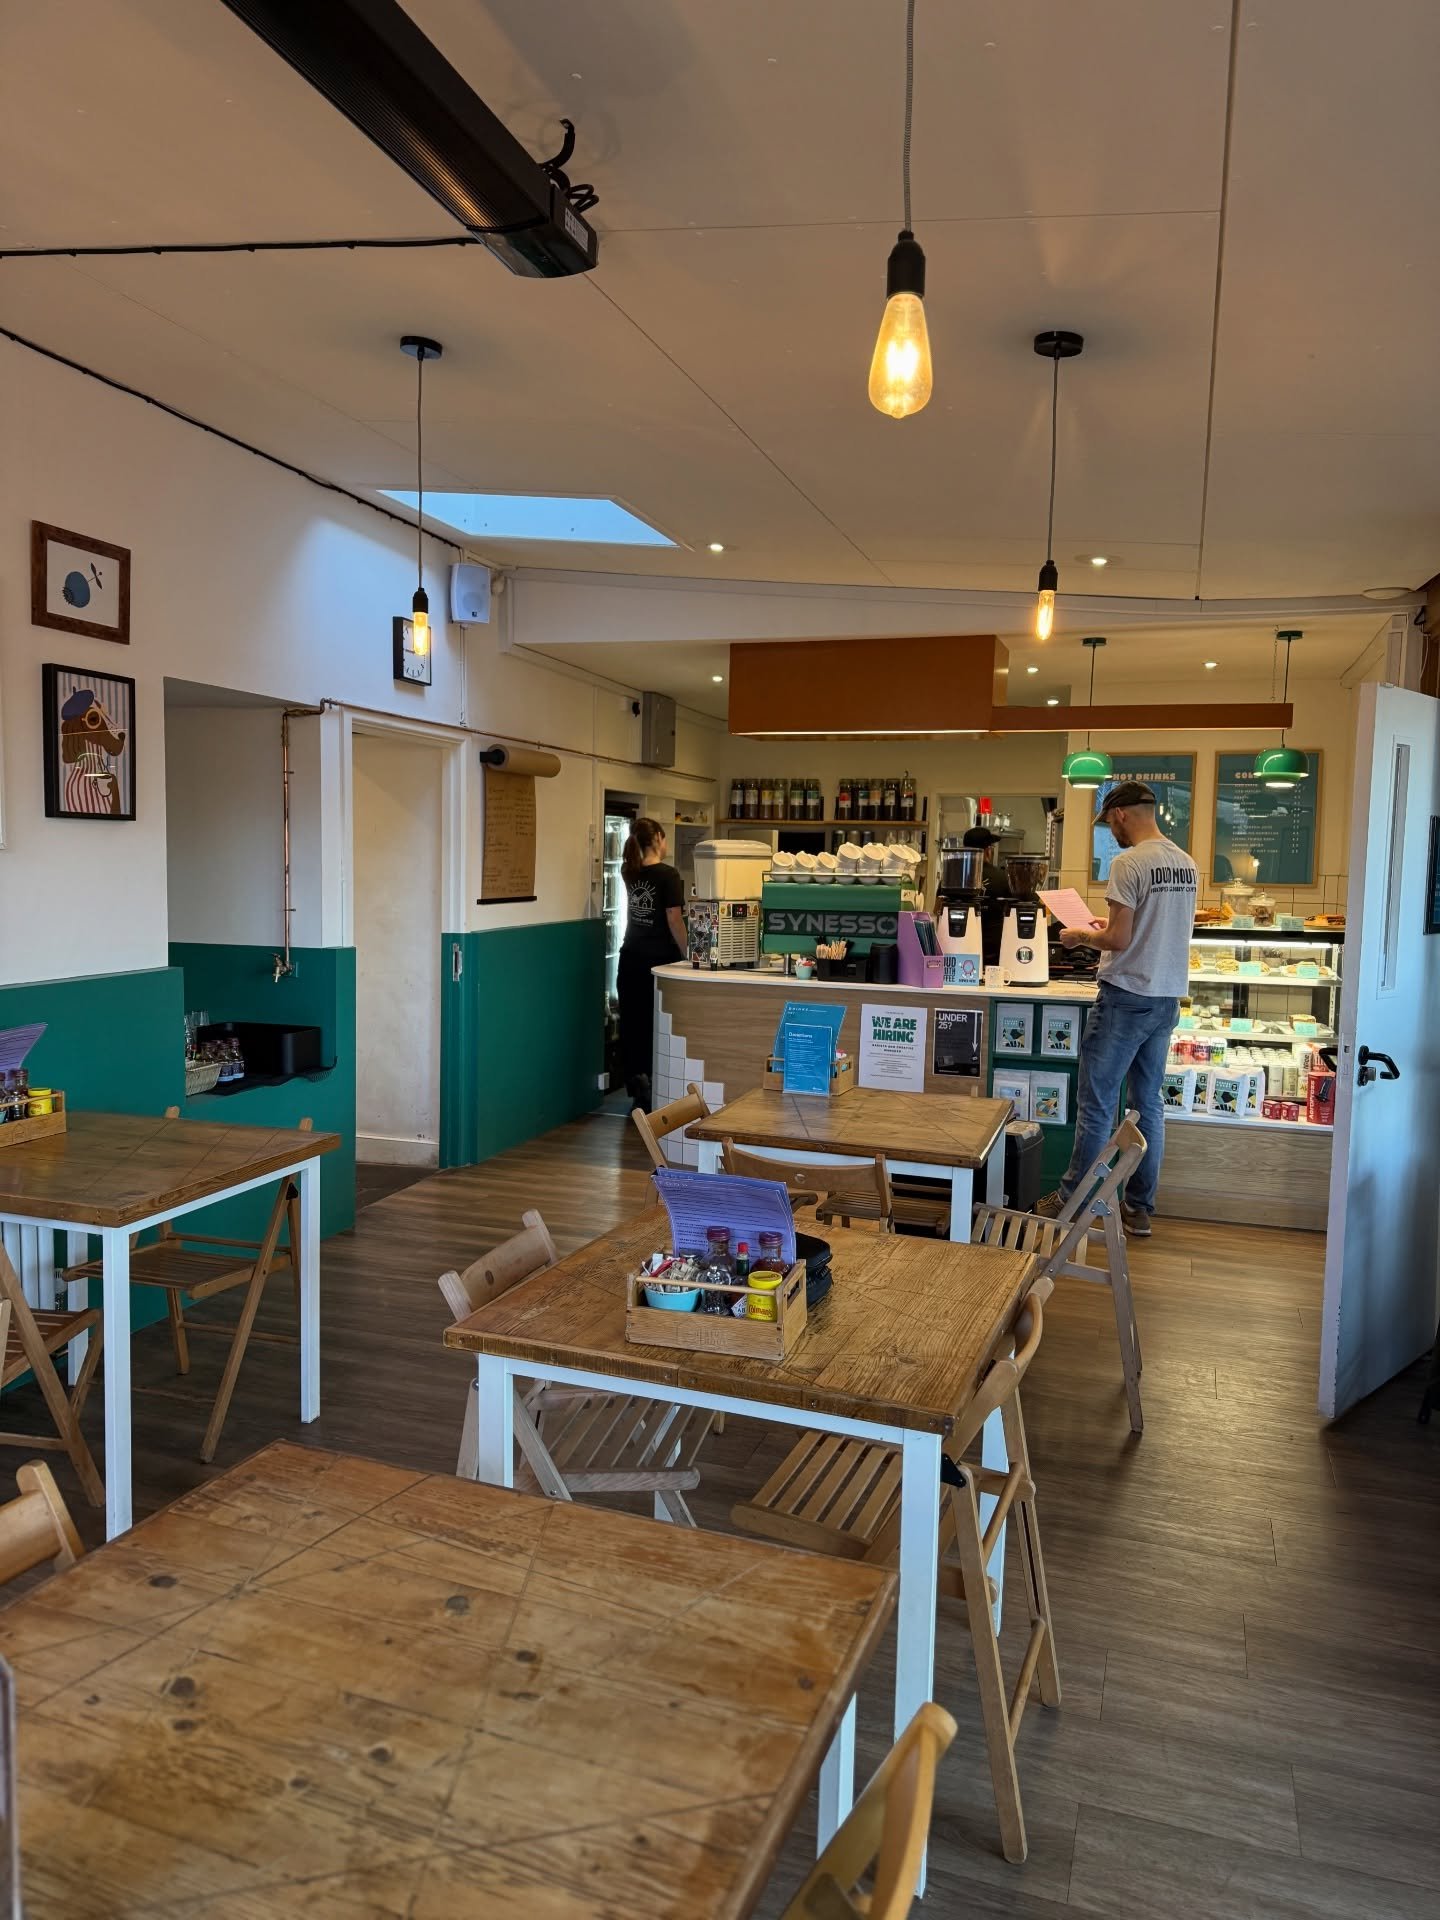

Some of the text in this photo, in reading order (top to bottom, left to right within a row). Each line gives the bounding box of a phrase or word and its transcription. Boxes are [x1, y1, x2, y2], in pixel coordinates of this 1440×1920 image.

[1112, 773, 1176, 781] HOT DRINKS
[768, 912, 899, 935] SYNESSO
[871, 1016, 917, 1030] WE ARE
[938, 1013, 968, 1022] UNDER
[938, 1021, 952, 1030] 25?
[872, 1029, 914, 1043] HIRING
